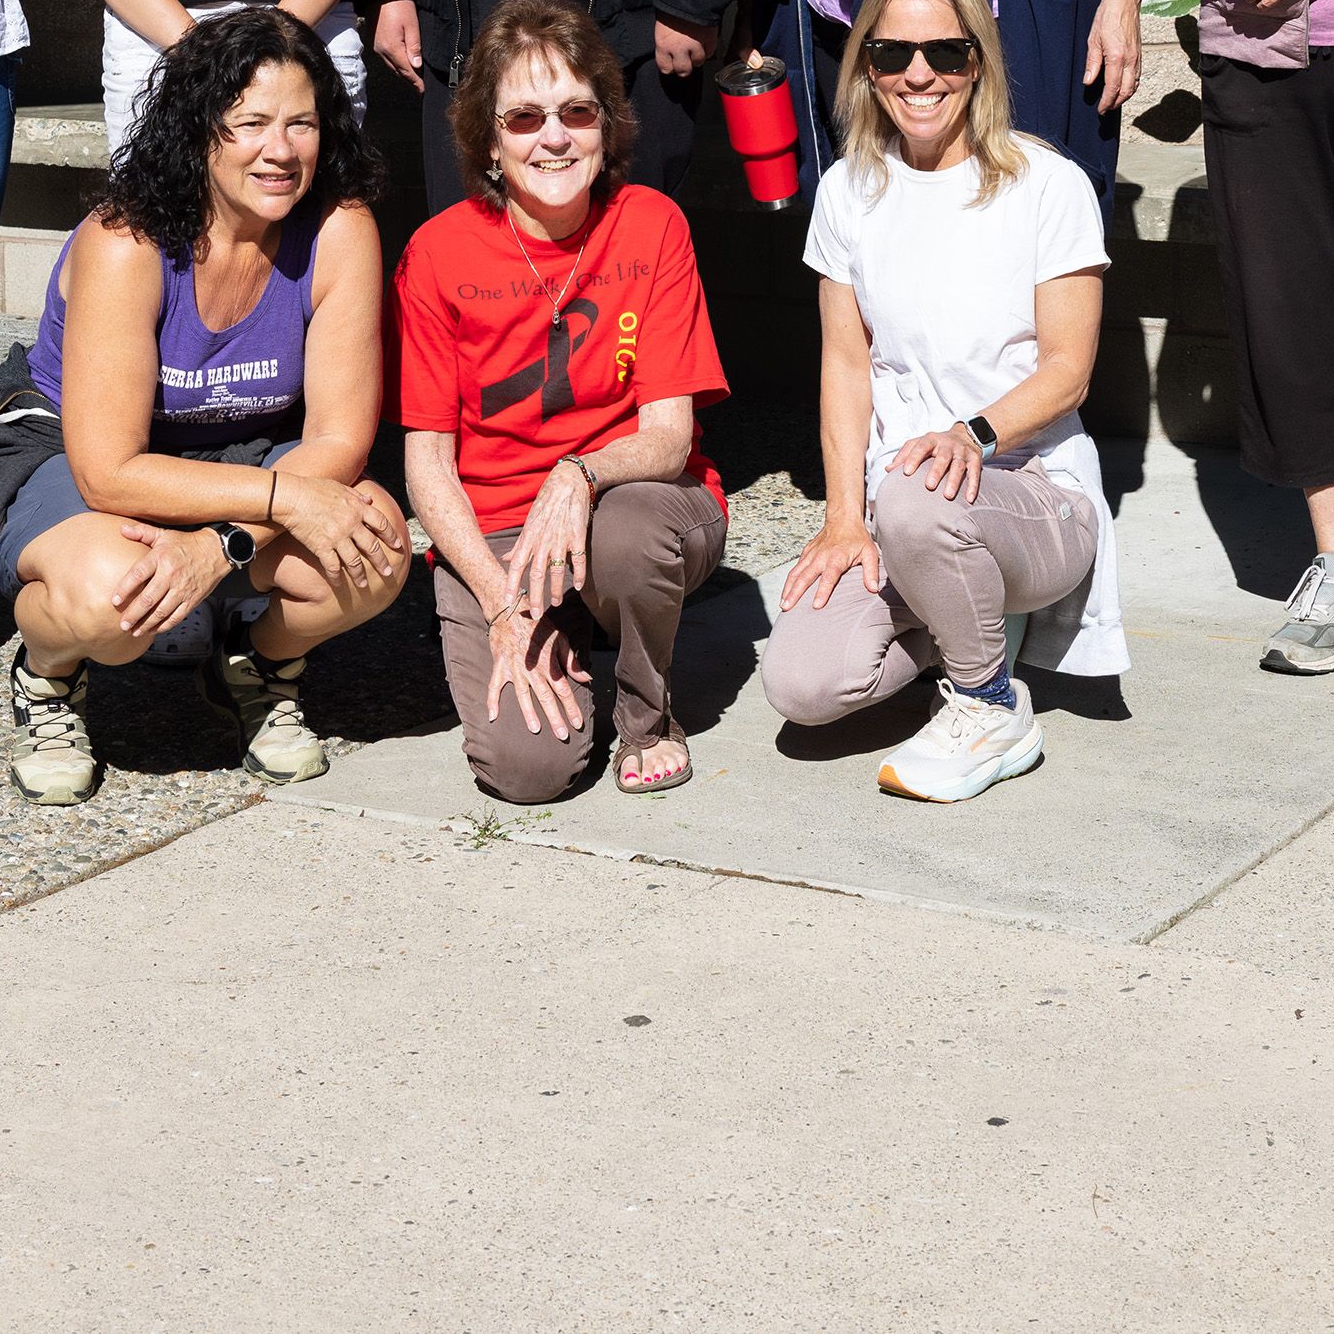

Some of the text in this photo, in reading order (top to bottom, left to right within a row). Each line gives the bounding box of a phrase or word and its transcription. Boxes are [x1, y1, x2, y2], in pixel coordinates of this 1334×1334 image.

[457, 259, 650, 300] One Walk One Life
[158, 359, 278, 389] SIERRA HARDWARE
